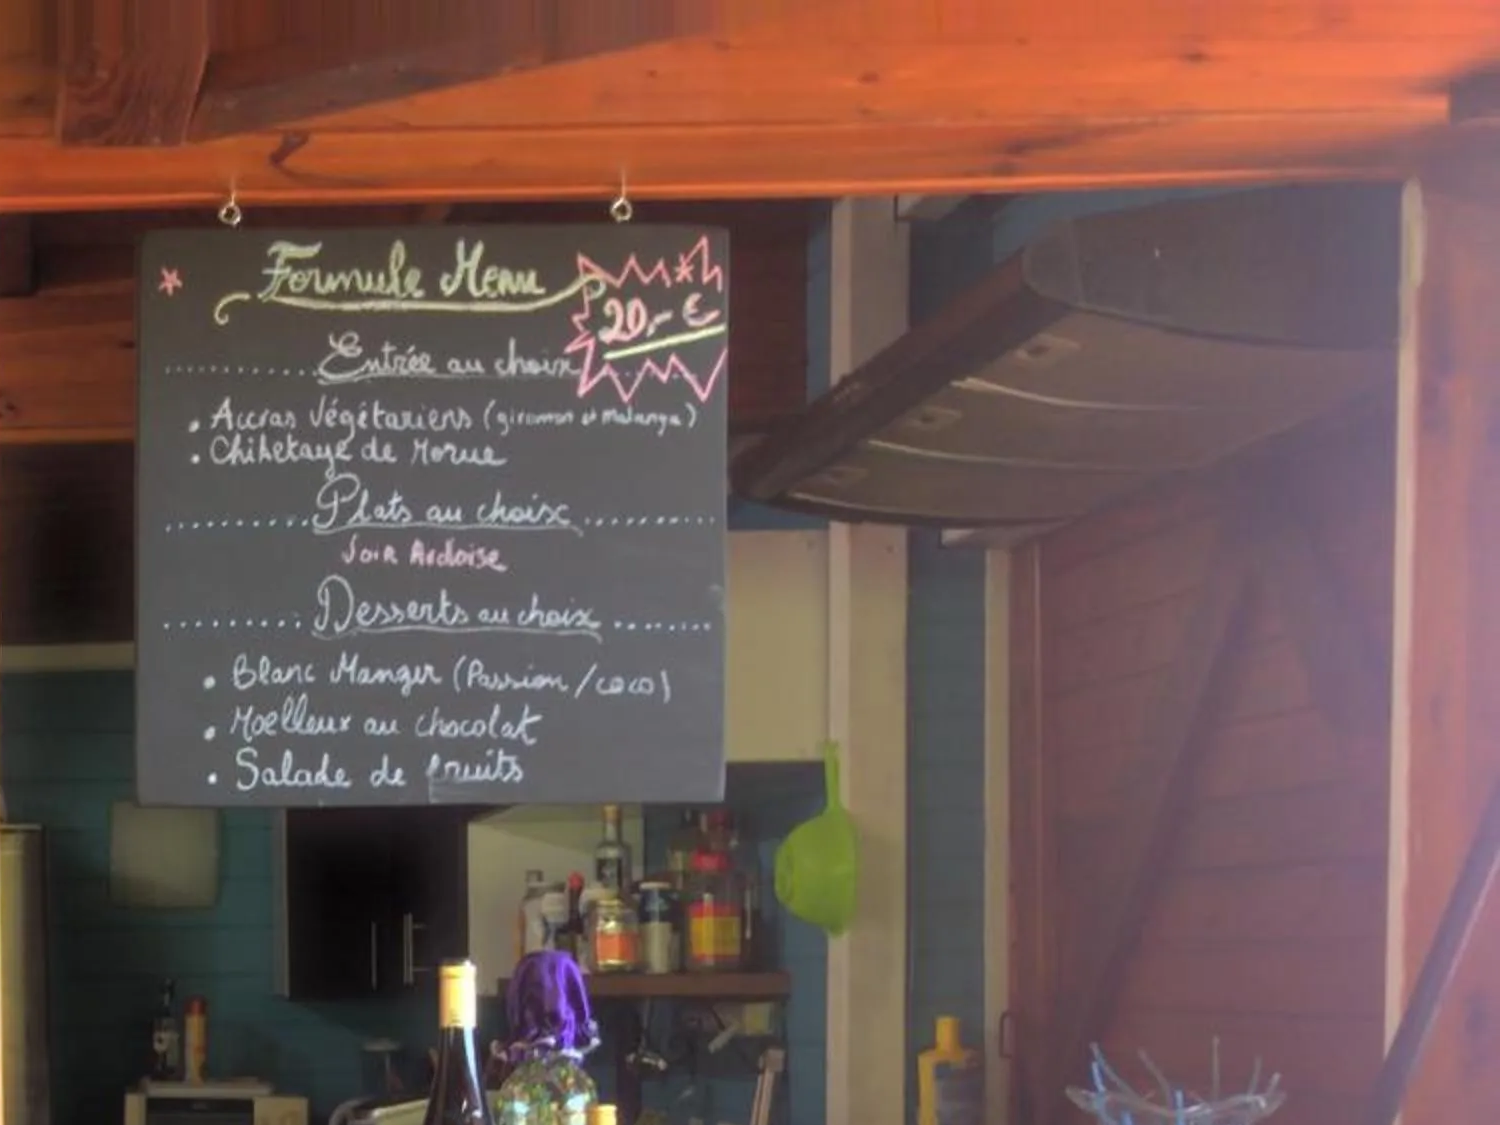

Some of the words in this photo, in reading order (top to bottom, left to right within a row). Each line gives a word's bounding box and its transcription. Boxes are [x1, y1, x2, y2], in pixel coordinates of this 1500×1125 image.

[261, 240, 425, 298] Formule
[440, 236, 545, 297] Menu
[318, 331, 436, 378] Entrée
[446, 357, 485, 375] au
[494, 337, 583, 376] choix
[210, 397, 296, 431] Accras
[310, 394, 473, 444] Végétariens
[360, 436, 398, 464] de
[410, 437, 508, 466] Morue
[312, 474, 412, 531] Plats
[426, 503, 463, 524] au
[477, 490, 573, 526] choix
[410, 537, 508, 573] Ardoise
[314, 574, 469, 633] Desserts
[478, 606, 510, 625] au
[517, 592, 603, 630] choix
[233, 653, 317, 691] Blanc
[330, 650, 443, 698] Manger
[230, 692, 352, 742] Moelleux
[364, 716, 400, 736] au
[415, 702, 543, 745] chocolat
[236, 747, 352, 790] Salade
[370, 754, 407, 788] de
